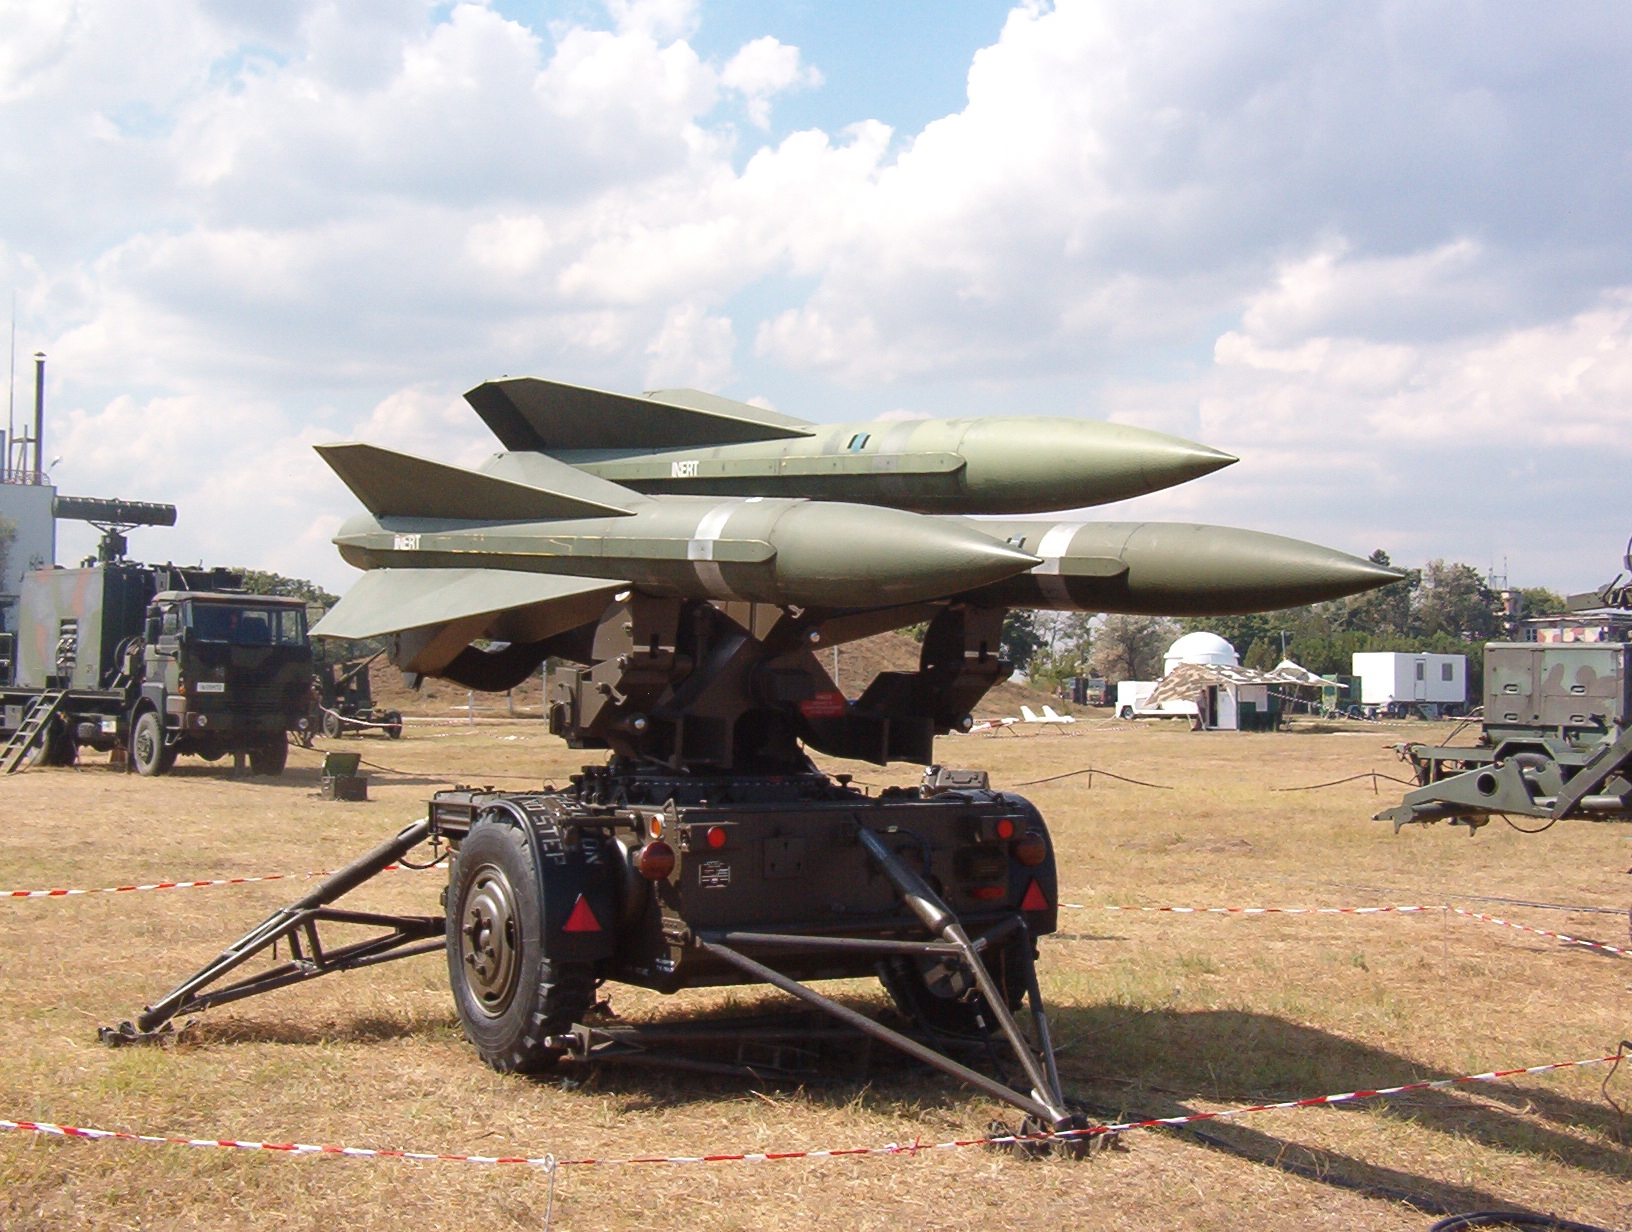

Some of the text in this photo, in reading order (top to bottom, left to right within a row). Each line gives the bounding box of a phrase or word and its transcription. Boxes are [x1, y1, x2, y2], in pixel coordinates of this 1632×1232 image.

[671, 460, 700, 478] INERT
[521, 799, 567, 865] NO STEP
